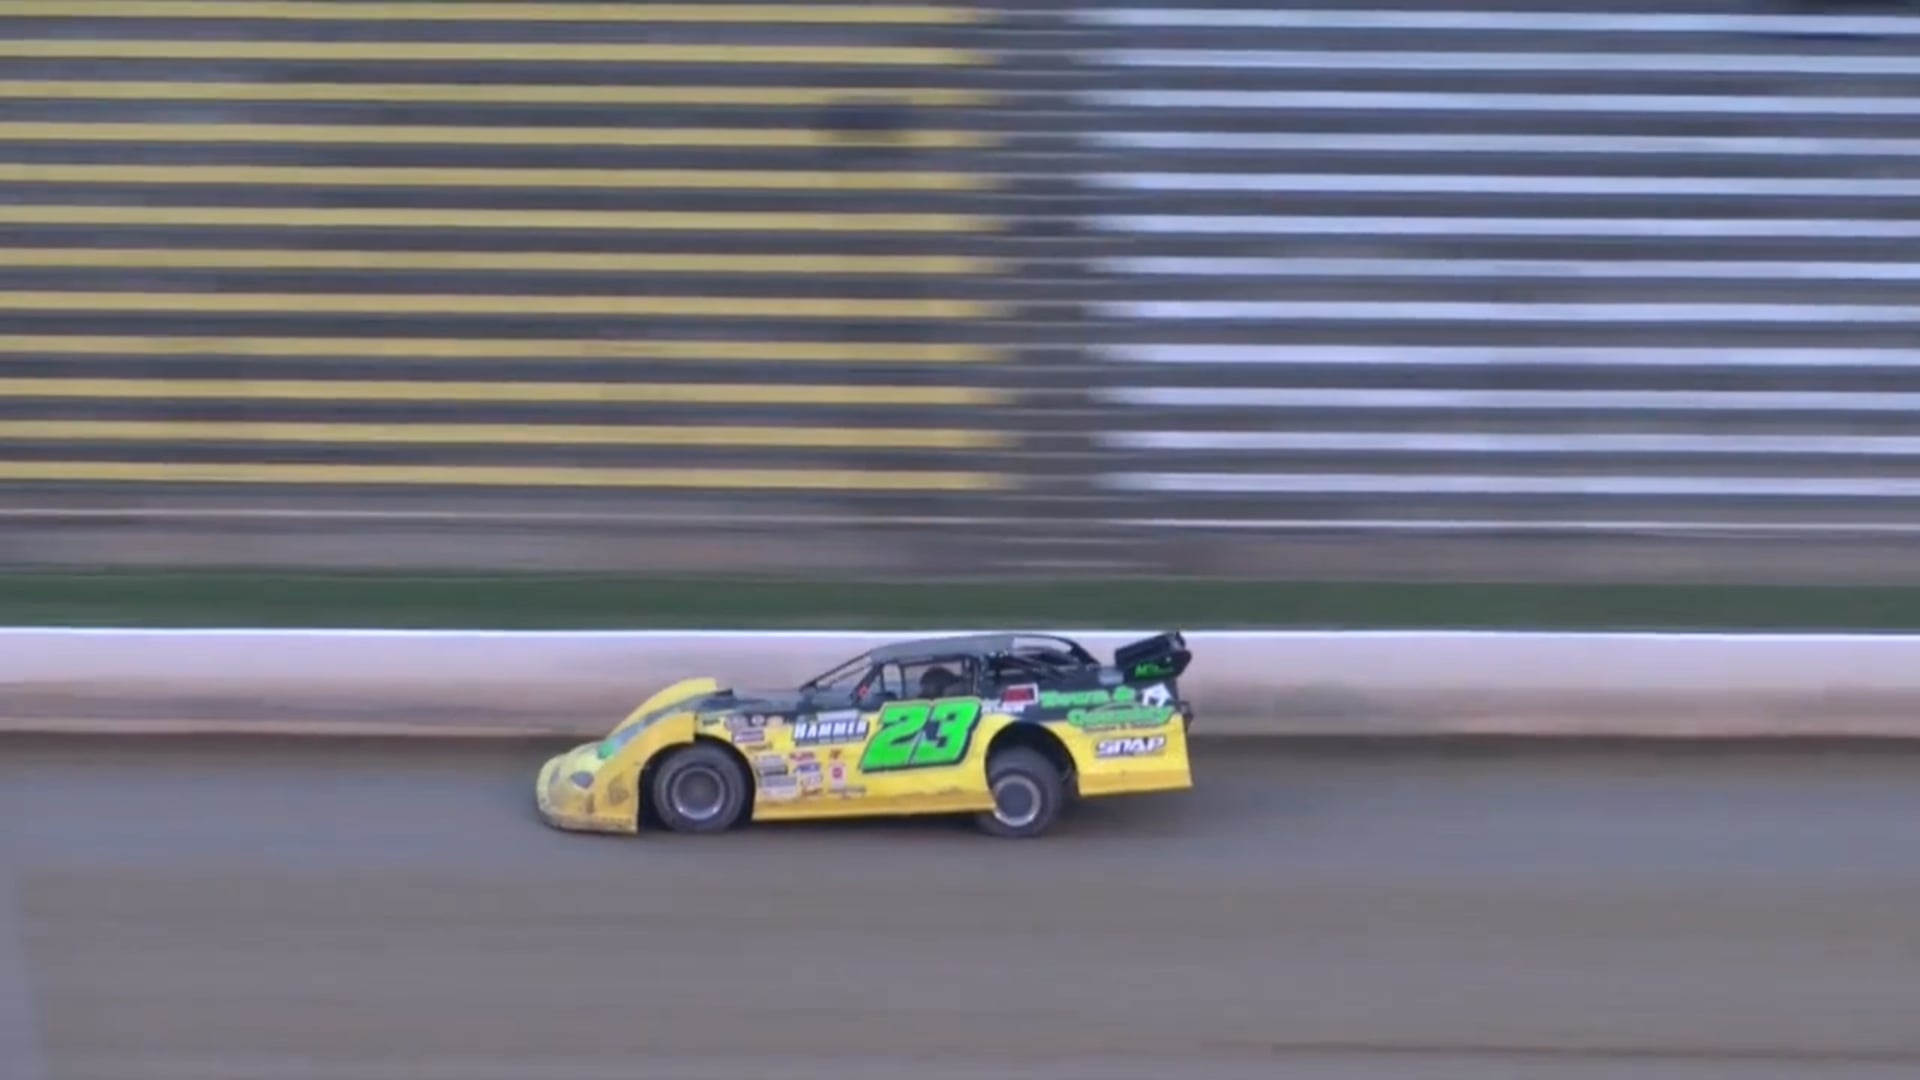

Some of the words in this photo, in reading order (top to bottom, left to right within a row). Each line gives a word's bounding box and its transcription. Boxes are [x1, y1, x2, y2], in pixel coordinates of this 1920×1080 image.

[794, 719, 868, 741] HAMMER
[860, 697, 982, 772] 23
[1096, 737, 1165, 756] SNAP
